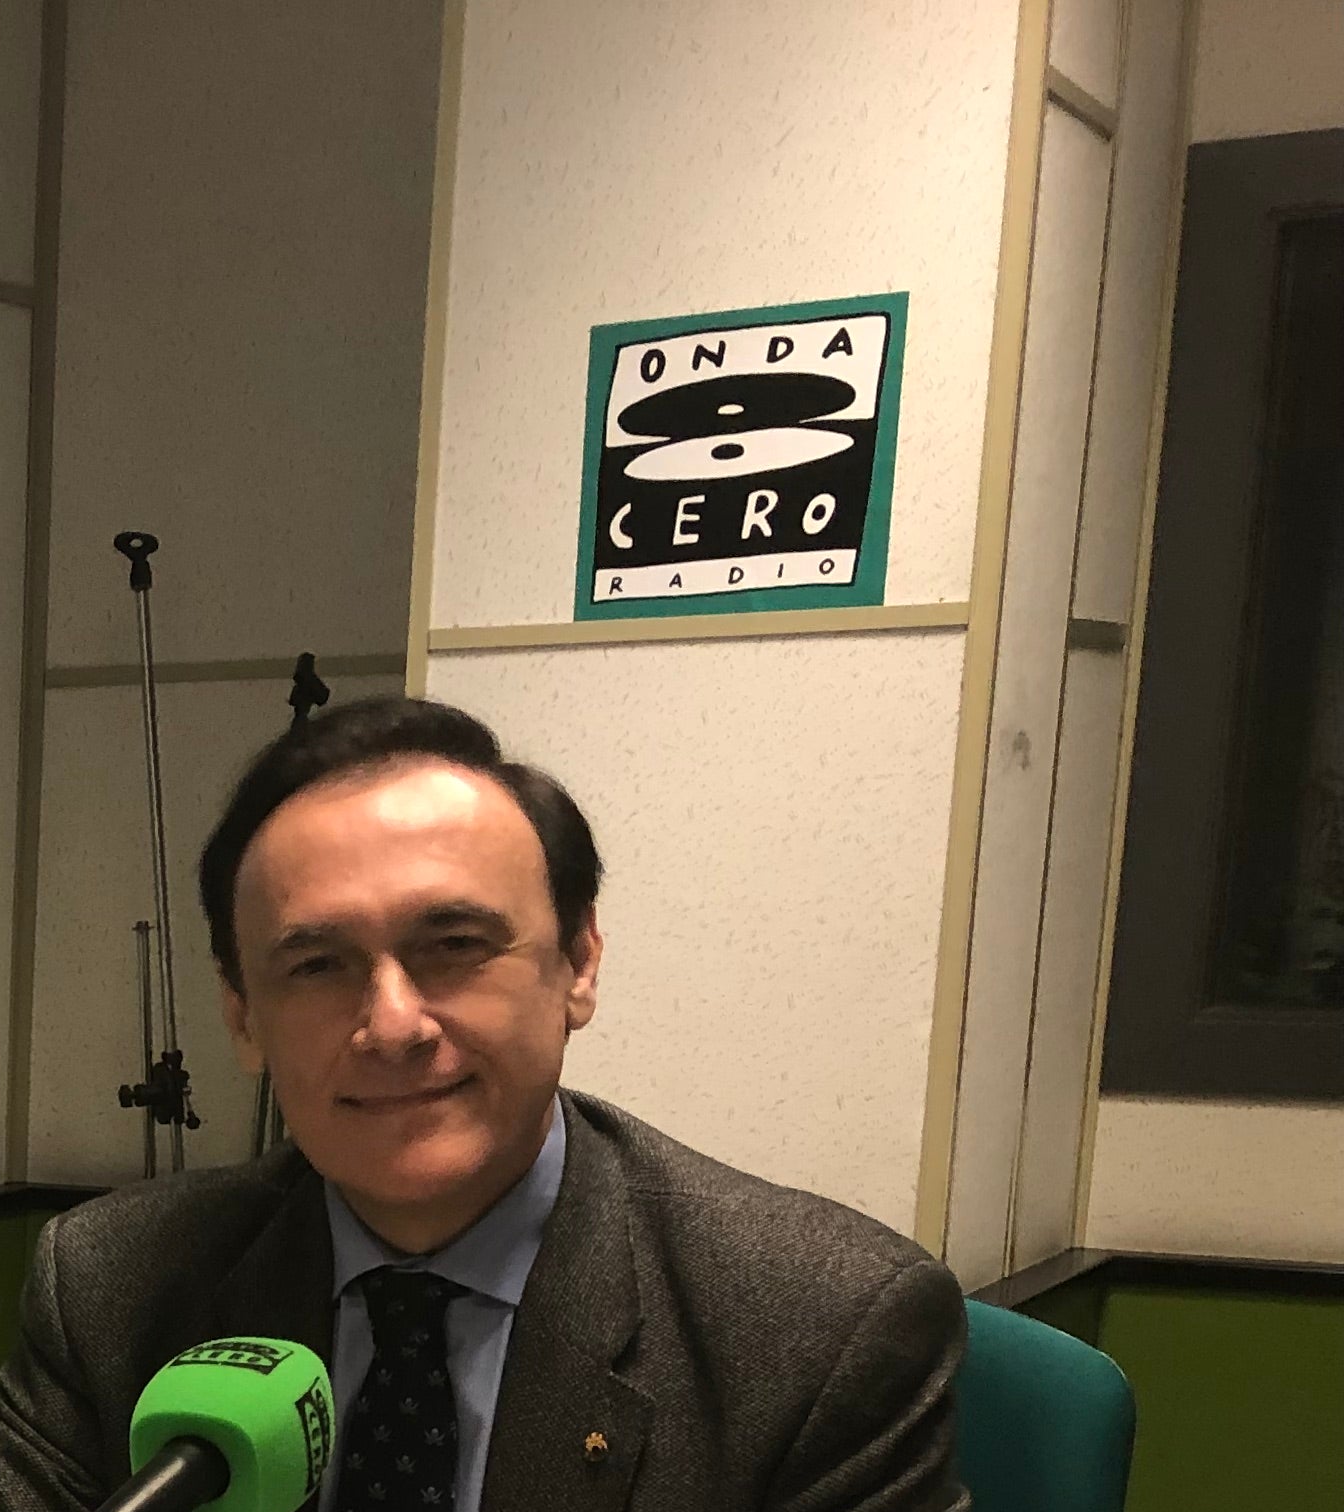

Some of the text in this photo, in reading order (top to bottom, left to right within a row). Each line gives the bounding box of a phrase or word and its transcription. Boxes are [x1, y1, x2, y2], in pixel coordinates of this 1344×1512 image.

[640, 327, 854, 383] ONDA
[608, 489, 837, 550] CERO
[608, 557, 836, 595] RADIO
